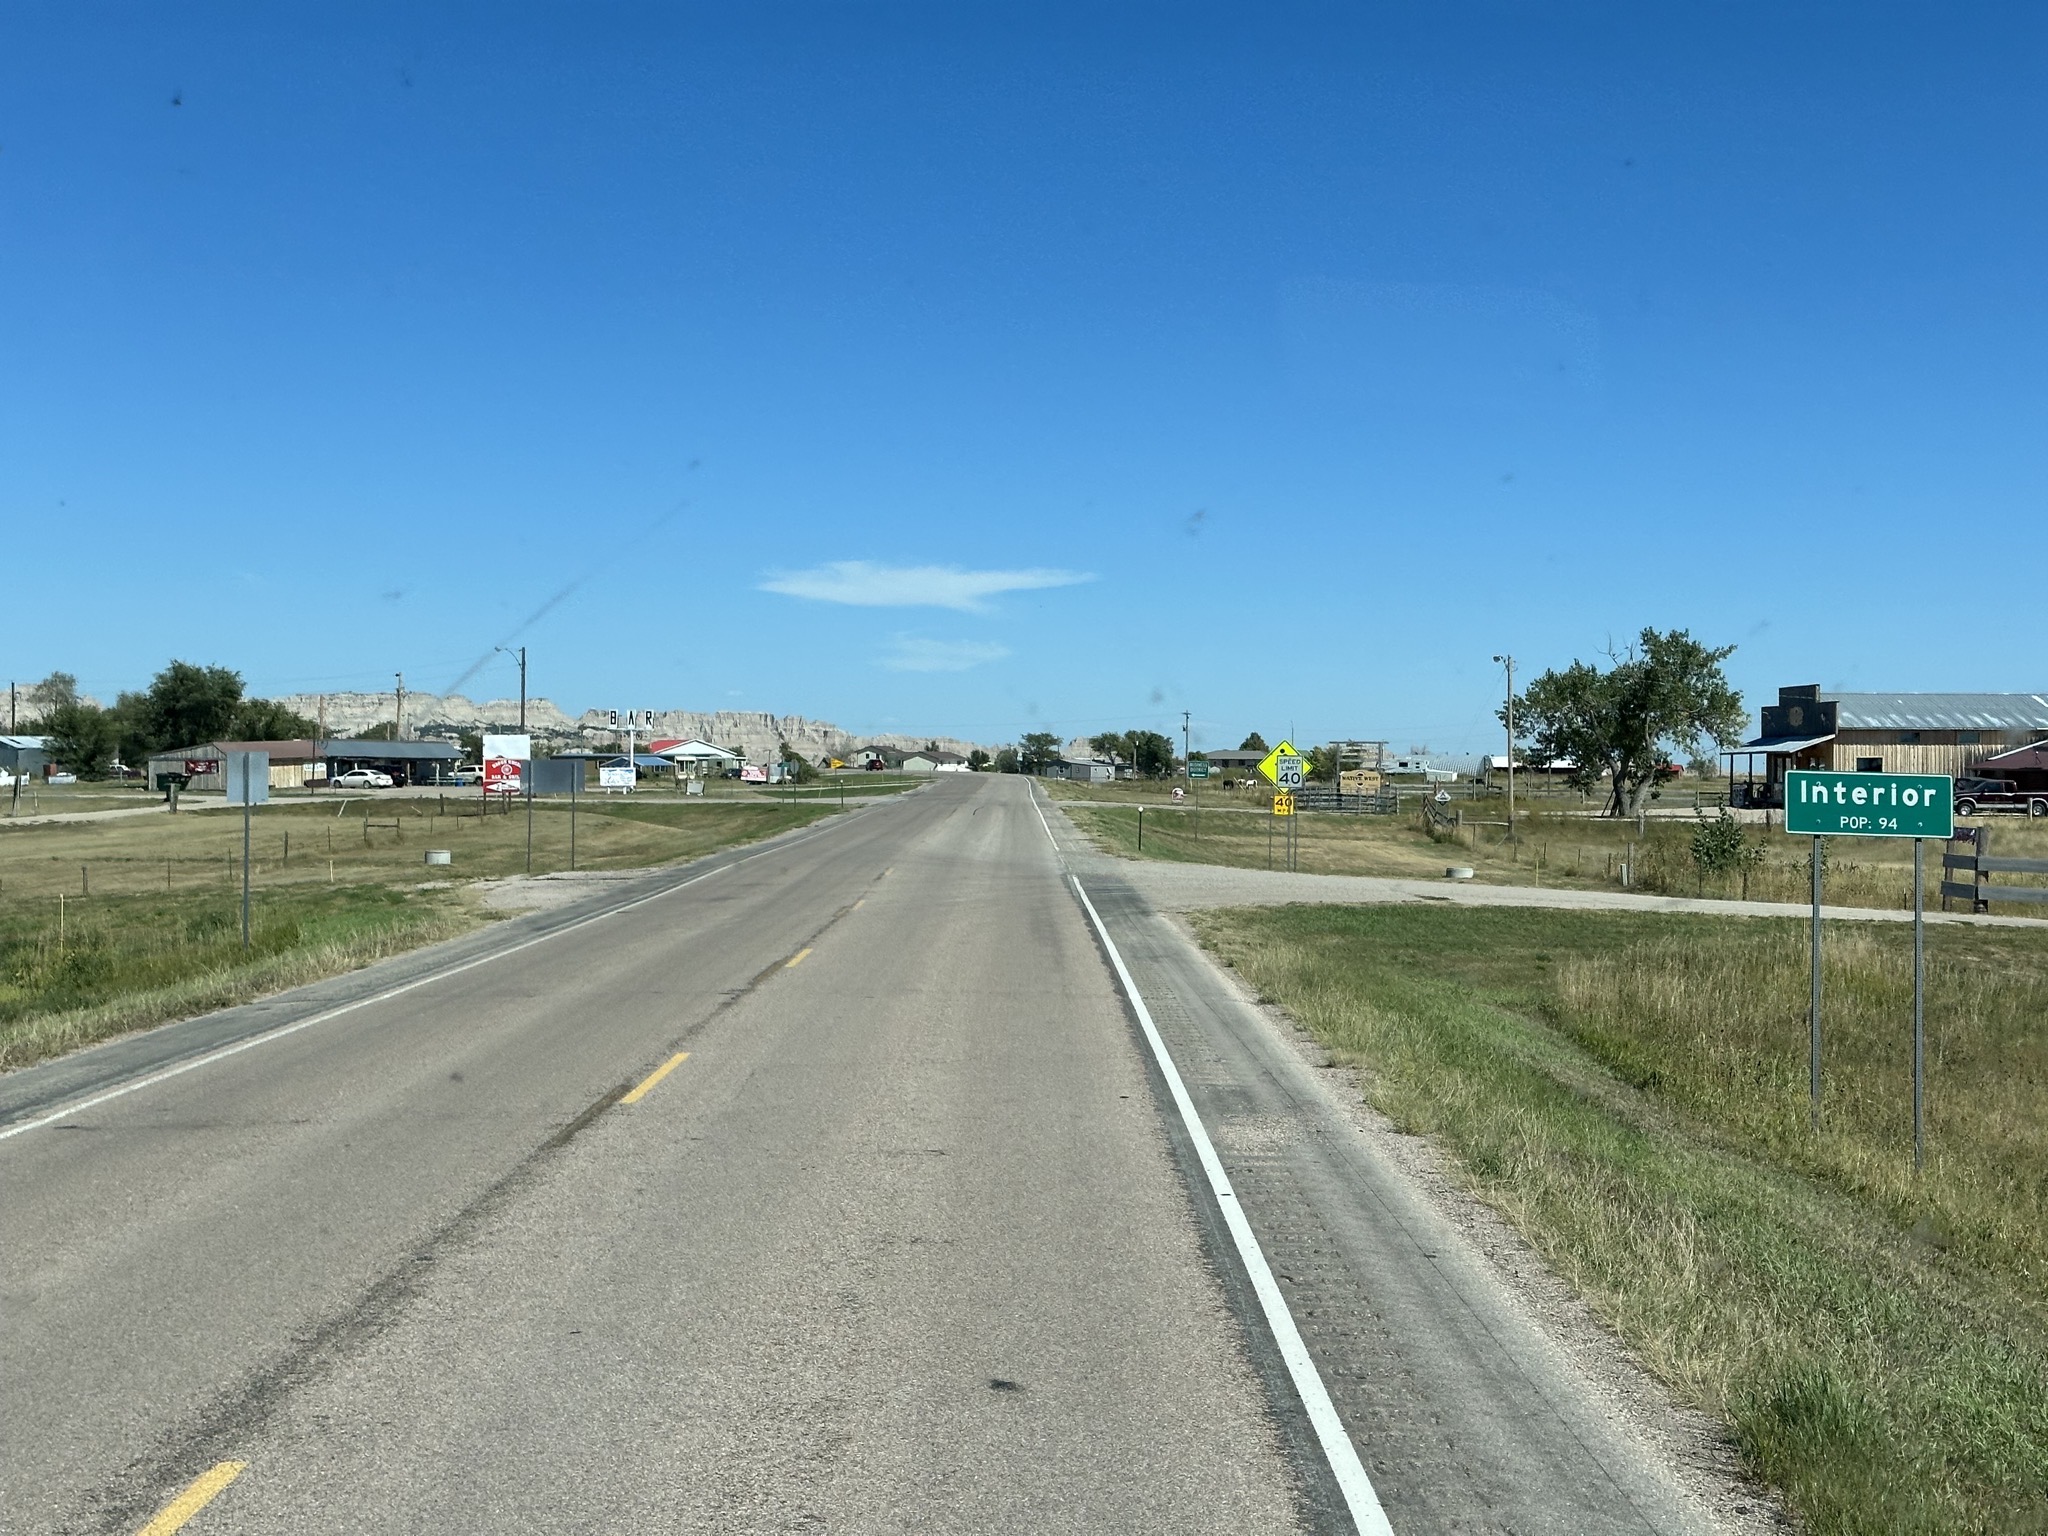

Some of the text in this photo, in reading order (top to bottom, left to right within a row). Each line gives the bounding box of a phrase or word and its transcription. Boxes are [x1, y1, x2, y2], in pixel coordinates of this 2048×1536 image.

[610, 710, 651, 725] BAR
[1279, 772, 1301, 784] 40
[1800, 779, 1936, 807] Interior
[1276, 798, 1292, 807] 40
[1878, 817, 1898, 830] 94
